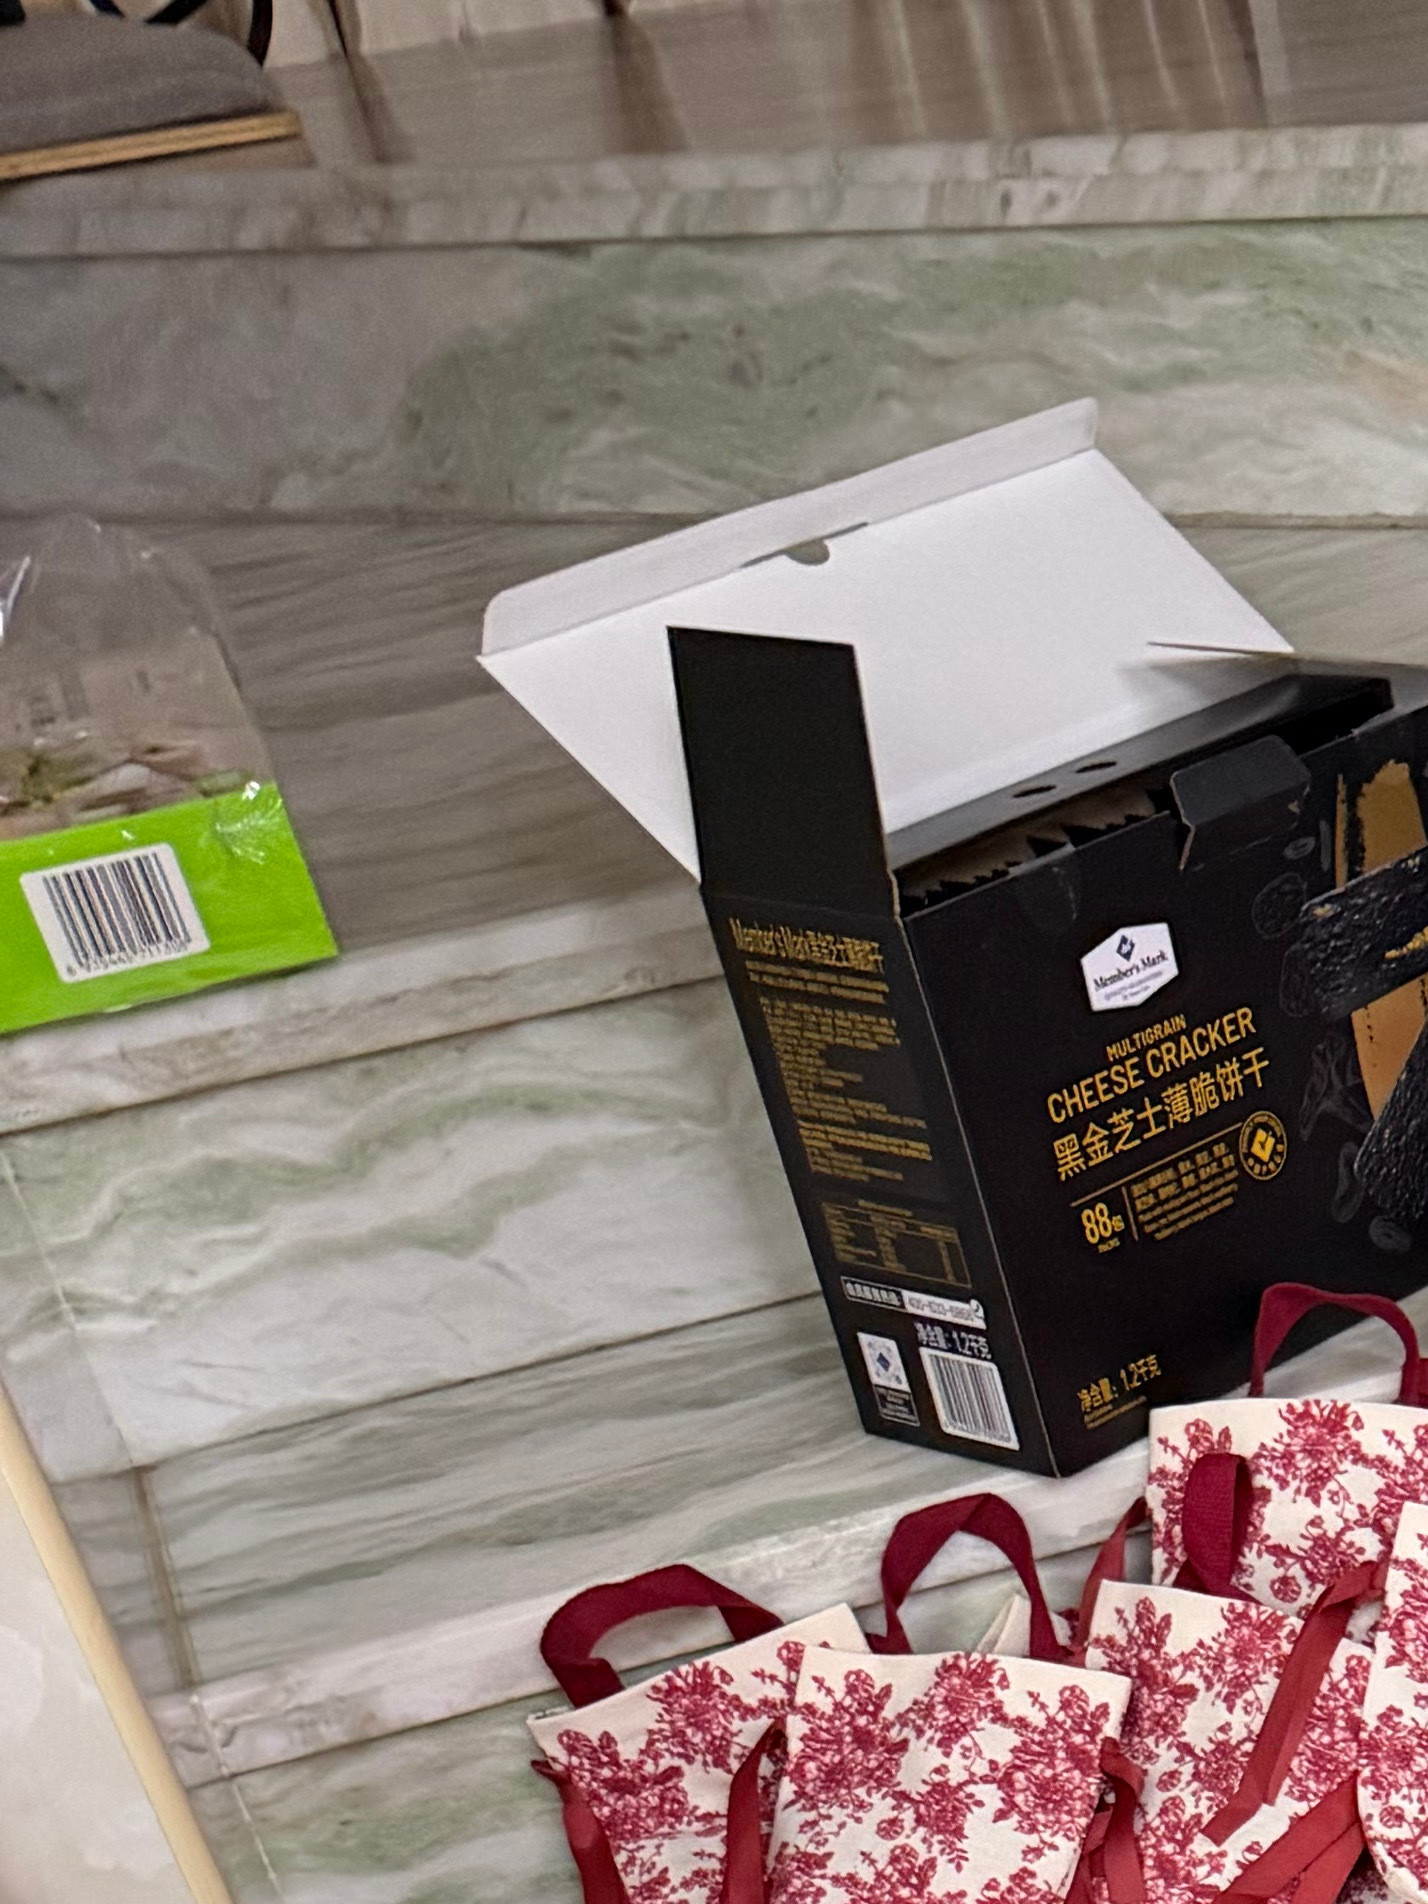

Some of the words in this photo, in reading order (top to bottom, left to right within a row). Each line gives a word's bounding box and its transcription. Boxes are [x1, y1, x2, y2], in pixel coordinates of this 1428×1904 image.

[1093, 963, 1141, 991] Member's
[1141, 950, 1169, 973] Mark
[1047, 1056, 1146, 1123] CHEESE
[1146, 1007, 1257, 1078] CRACKER
[1106, 1014, 1187, 1062] MULTIGRAIN
[1053, 1047, 1270, 1181] 黑金芝士薄脆饼干
